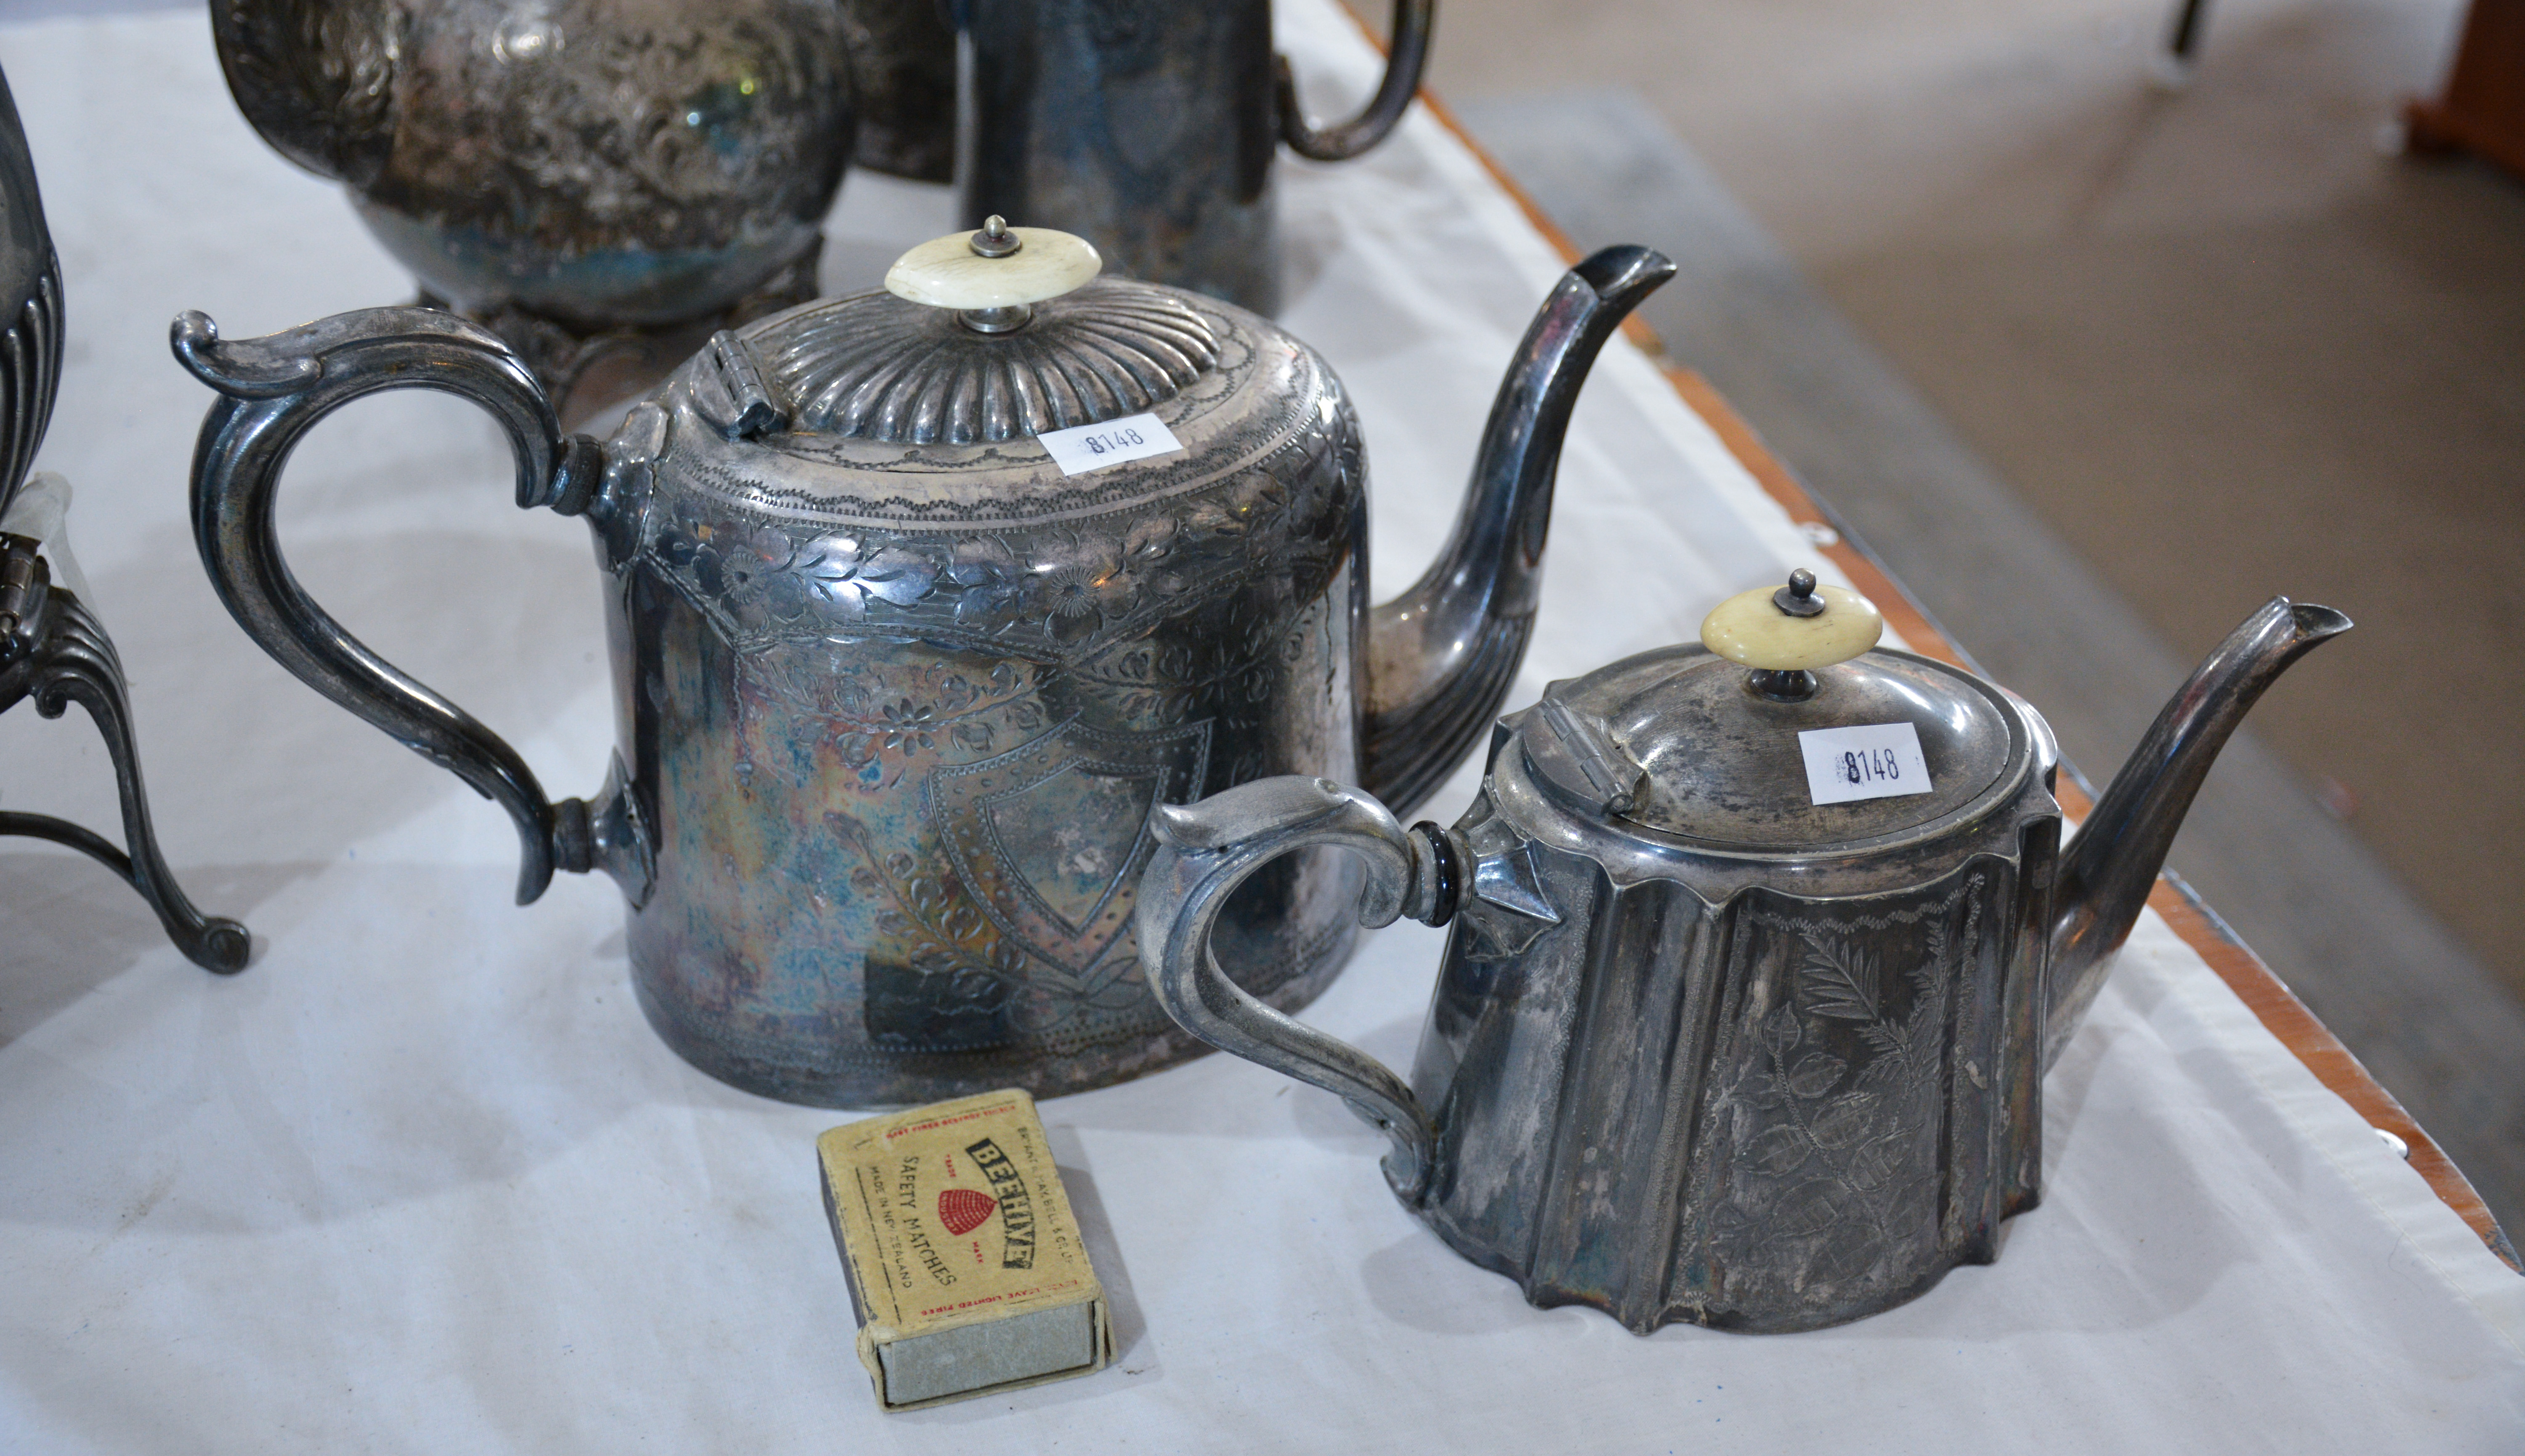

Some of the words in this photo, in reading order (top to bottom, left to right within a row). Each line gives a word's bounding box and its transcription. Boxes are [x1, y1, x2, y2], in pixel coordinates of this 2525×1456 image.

[1085, 428, 1144, 454] 8148
[1845, 748, 1899, 784] 8148
[899, 1156, 920, 1209] SAFETY
[945, 1154, 957, 1177] TRADE
[869, 1166, 885, 1194] MADE
[879, 1197, 889, 1208] IN
[971, 1142, 1034, 1264] BEEHIVE
[903, 1217, 957, 1286] MATCHES
[973, 1241, 984, 1264] MARK
[958, 1295, 1002, 1309] LIGHTED
